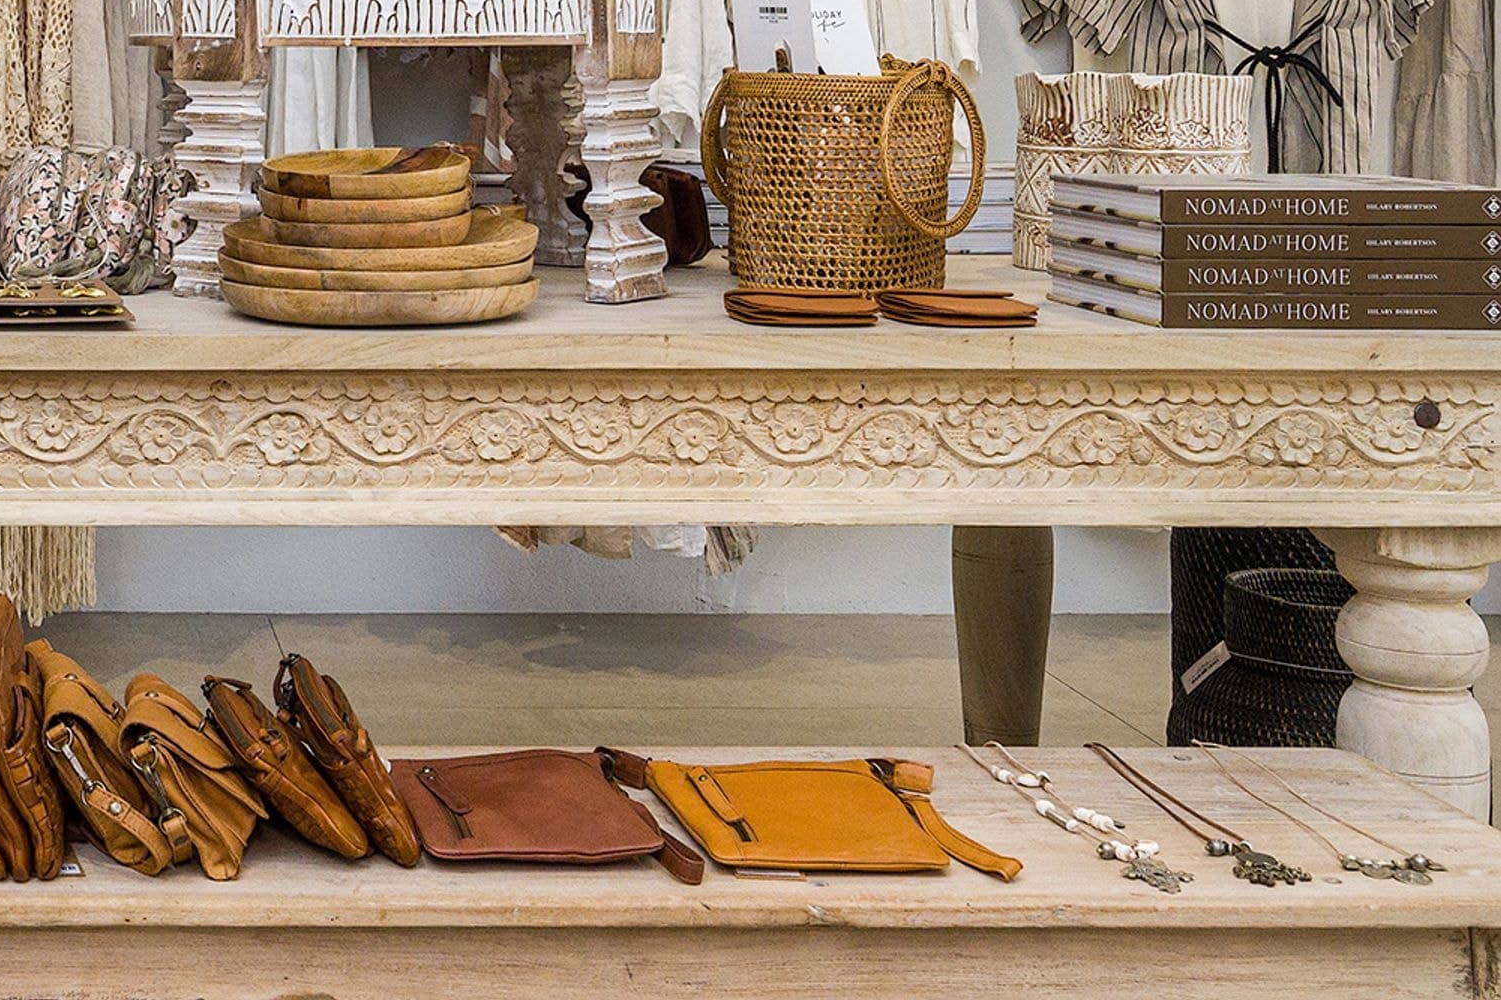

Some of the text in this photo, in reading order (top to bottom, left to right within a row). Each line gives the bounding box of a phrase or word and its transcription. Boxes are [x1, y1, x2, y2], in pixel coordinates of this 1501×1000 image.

[1185, 197, 1349, 216] NOMAD AT HOME
[1186, 234, 1349, 252] NOMAD AT HOME
[1188, 268, 1351, 286] NOMAD AT HOME
[1187, 302, 1350, 320] NOMAD AT HOME
